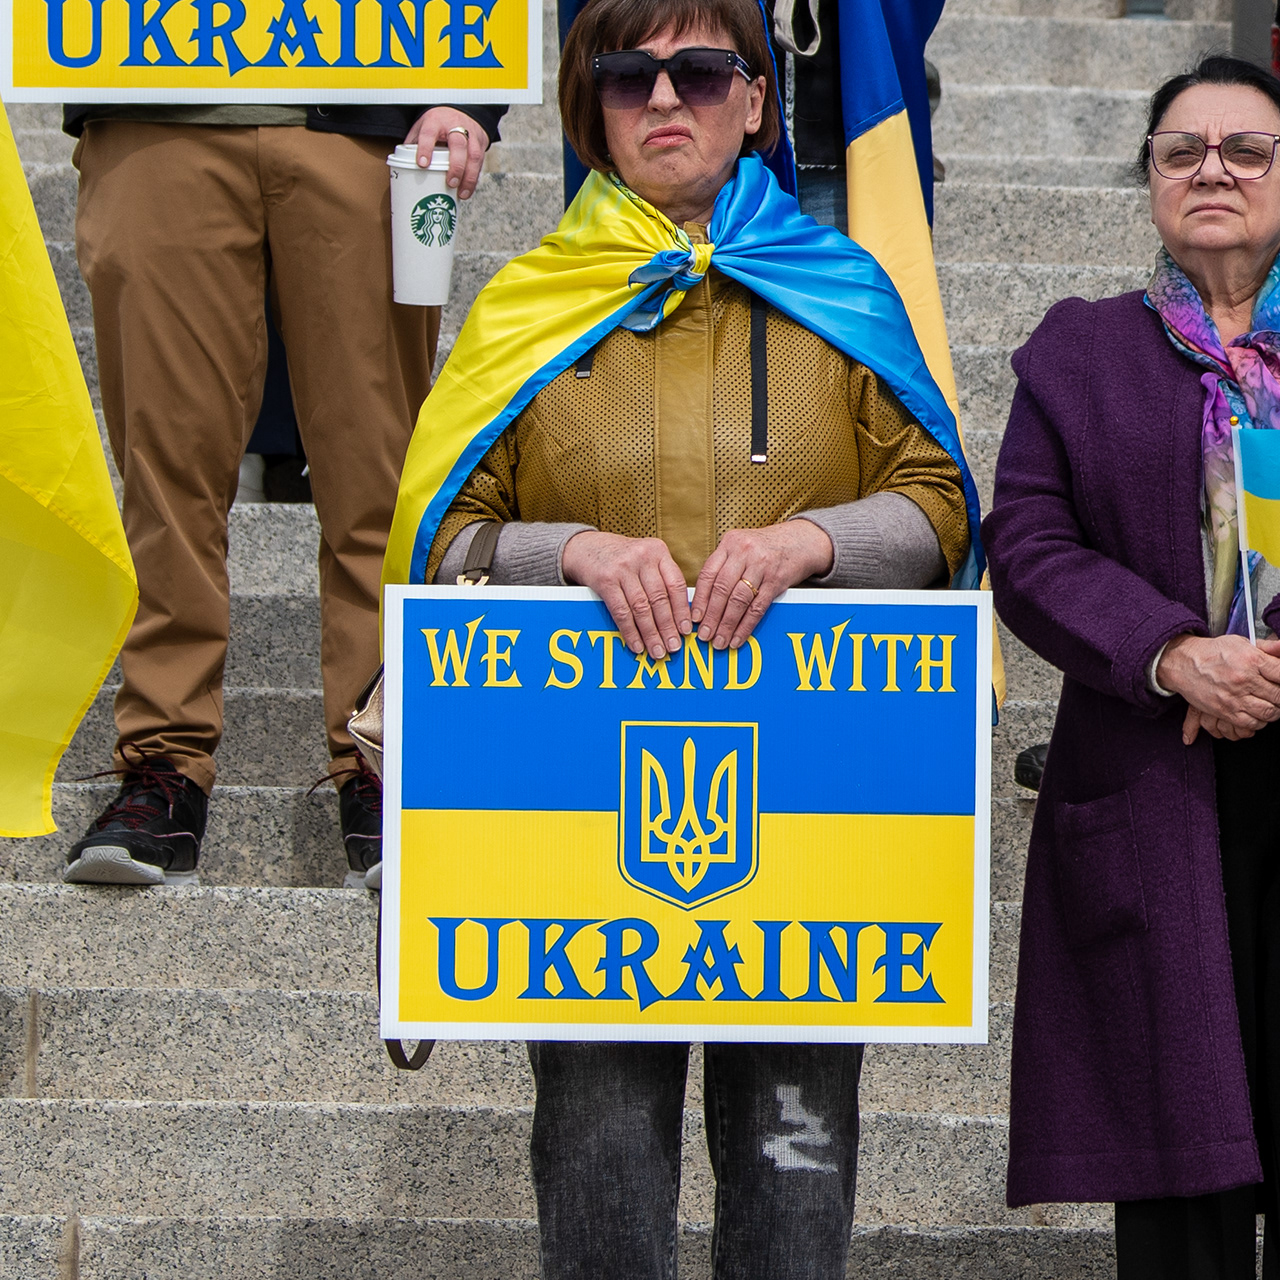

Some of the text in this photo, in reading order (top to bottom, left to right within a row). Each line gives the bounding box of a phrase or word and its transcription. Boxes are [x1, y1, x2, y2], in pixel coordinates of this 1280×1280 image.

[420, 612, 959, 694] WE STAND WITH
[428, 917, 949, 1014] UKRAINE
